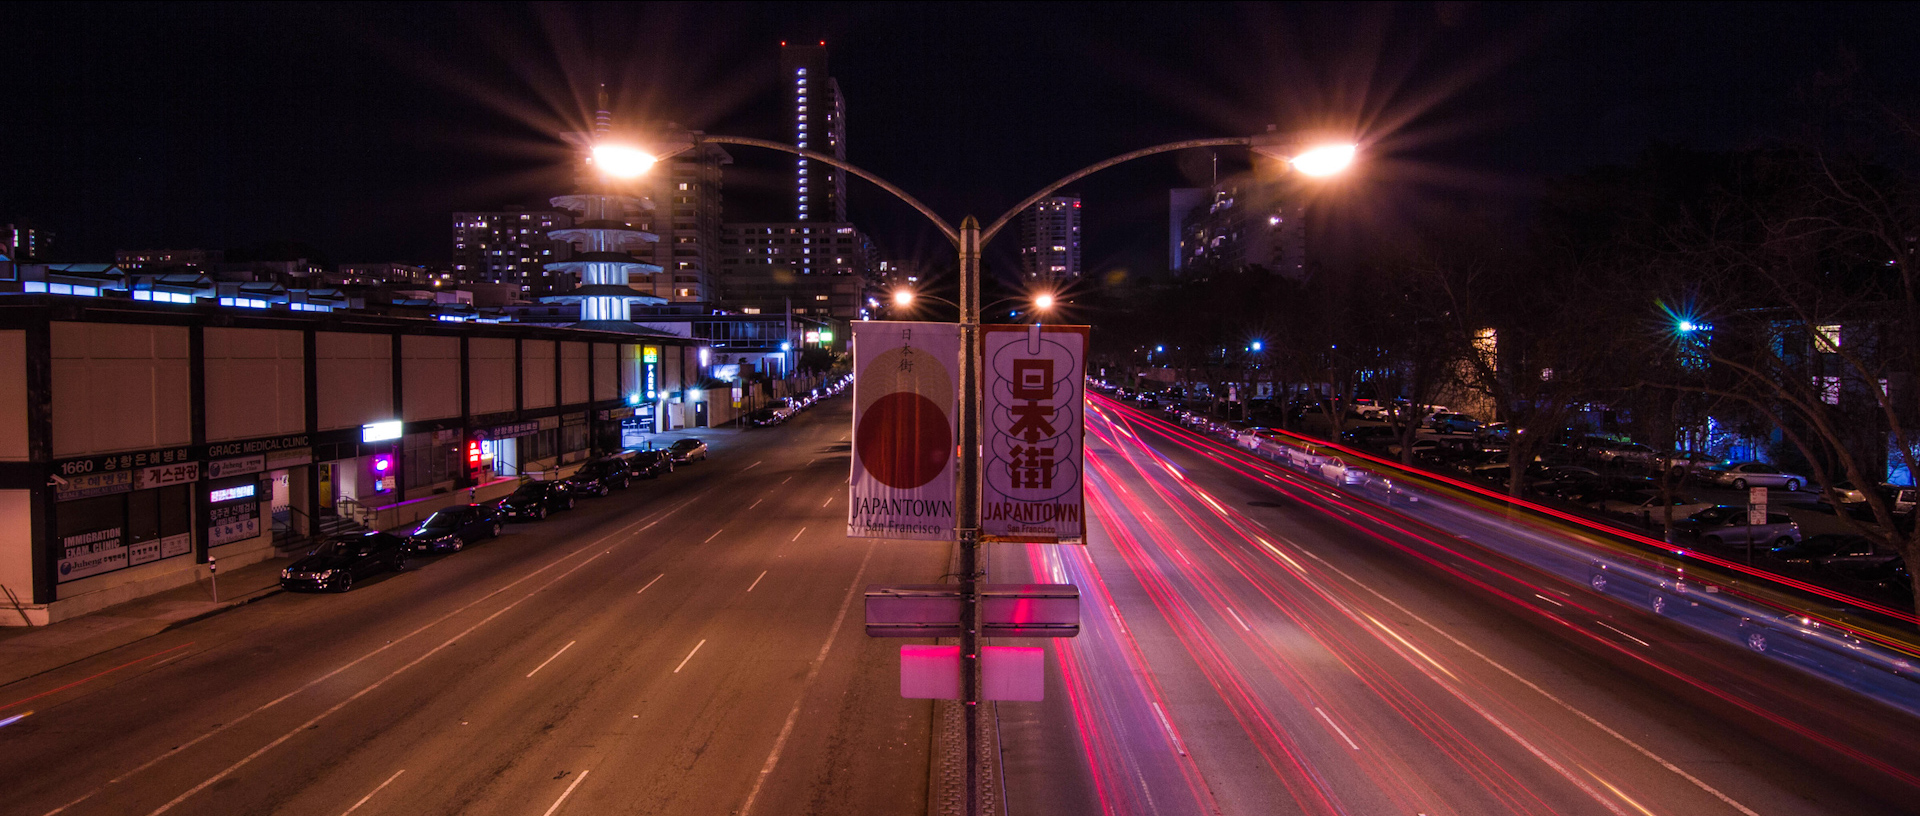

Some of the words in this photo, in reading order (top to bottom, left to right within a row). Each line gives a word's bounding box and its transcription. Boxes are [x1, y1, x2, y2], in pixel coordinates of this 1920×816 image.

[900, 328, 914, 373] 日本街
[1009, 359, 1056, 489] 日本街
[208, 443, 242, 457] GRACE
[243, 439, 282, 453] MEDICAL
[282, 435, 309, 448] CLINIC
[61, 459, 94, 475] 1660
[150, 465, 197, 483] 게스관광
[853, 497, 952, 518] JAPANTOWN
[984, 502, 1079, 522] JAPANTOWN
[865, 520, 884, 533] San
[887, 522, 941, 534] Francisco
[1007, 524, 1021, 533] San
[1022, 524, 1055, 534] Francisco
[63, 527, 121, 548] IMMIGRATION
[65, 544, 92, 559] EXAM.
[92, 538, 121, 553] CLINIC
[72, 557, 102, 569] Juheng
